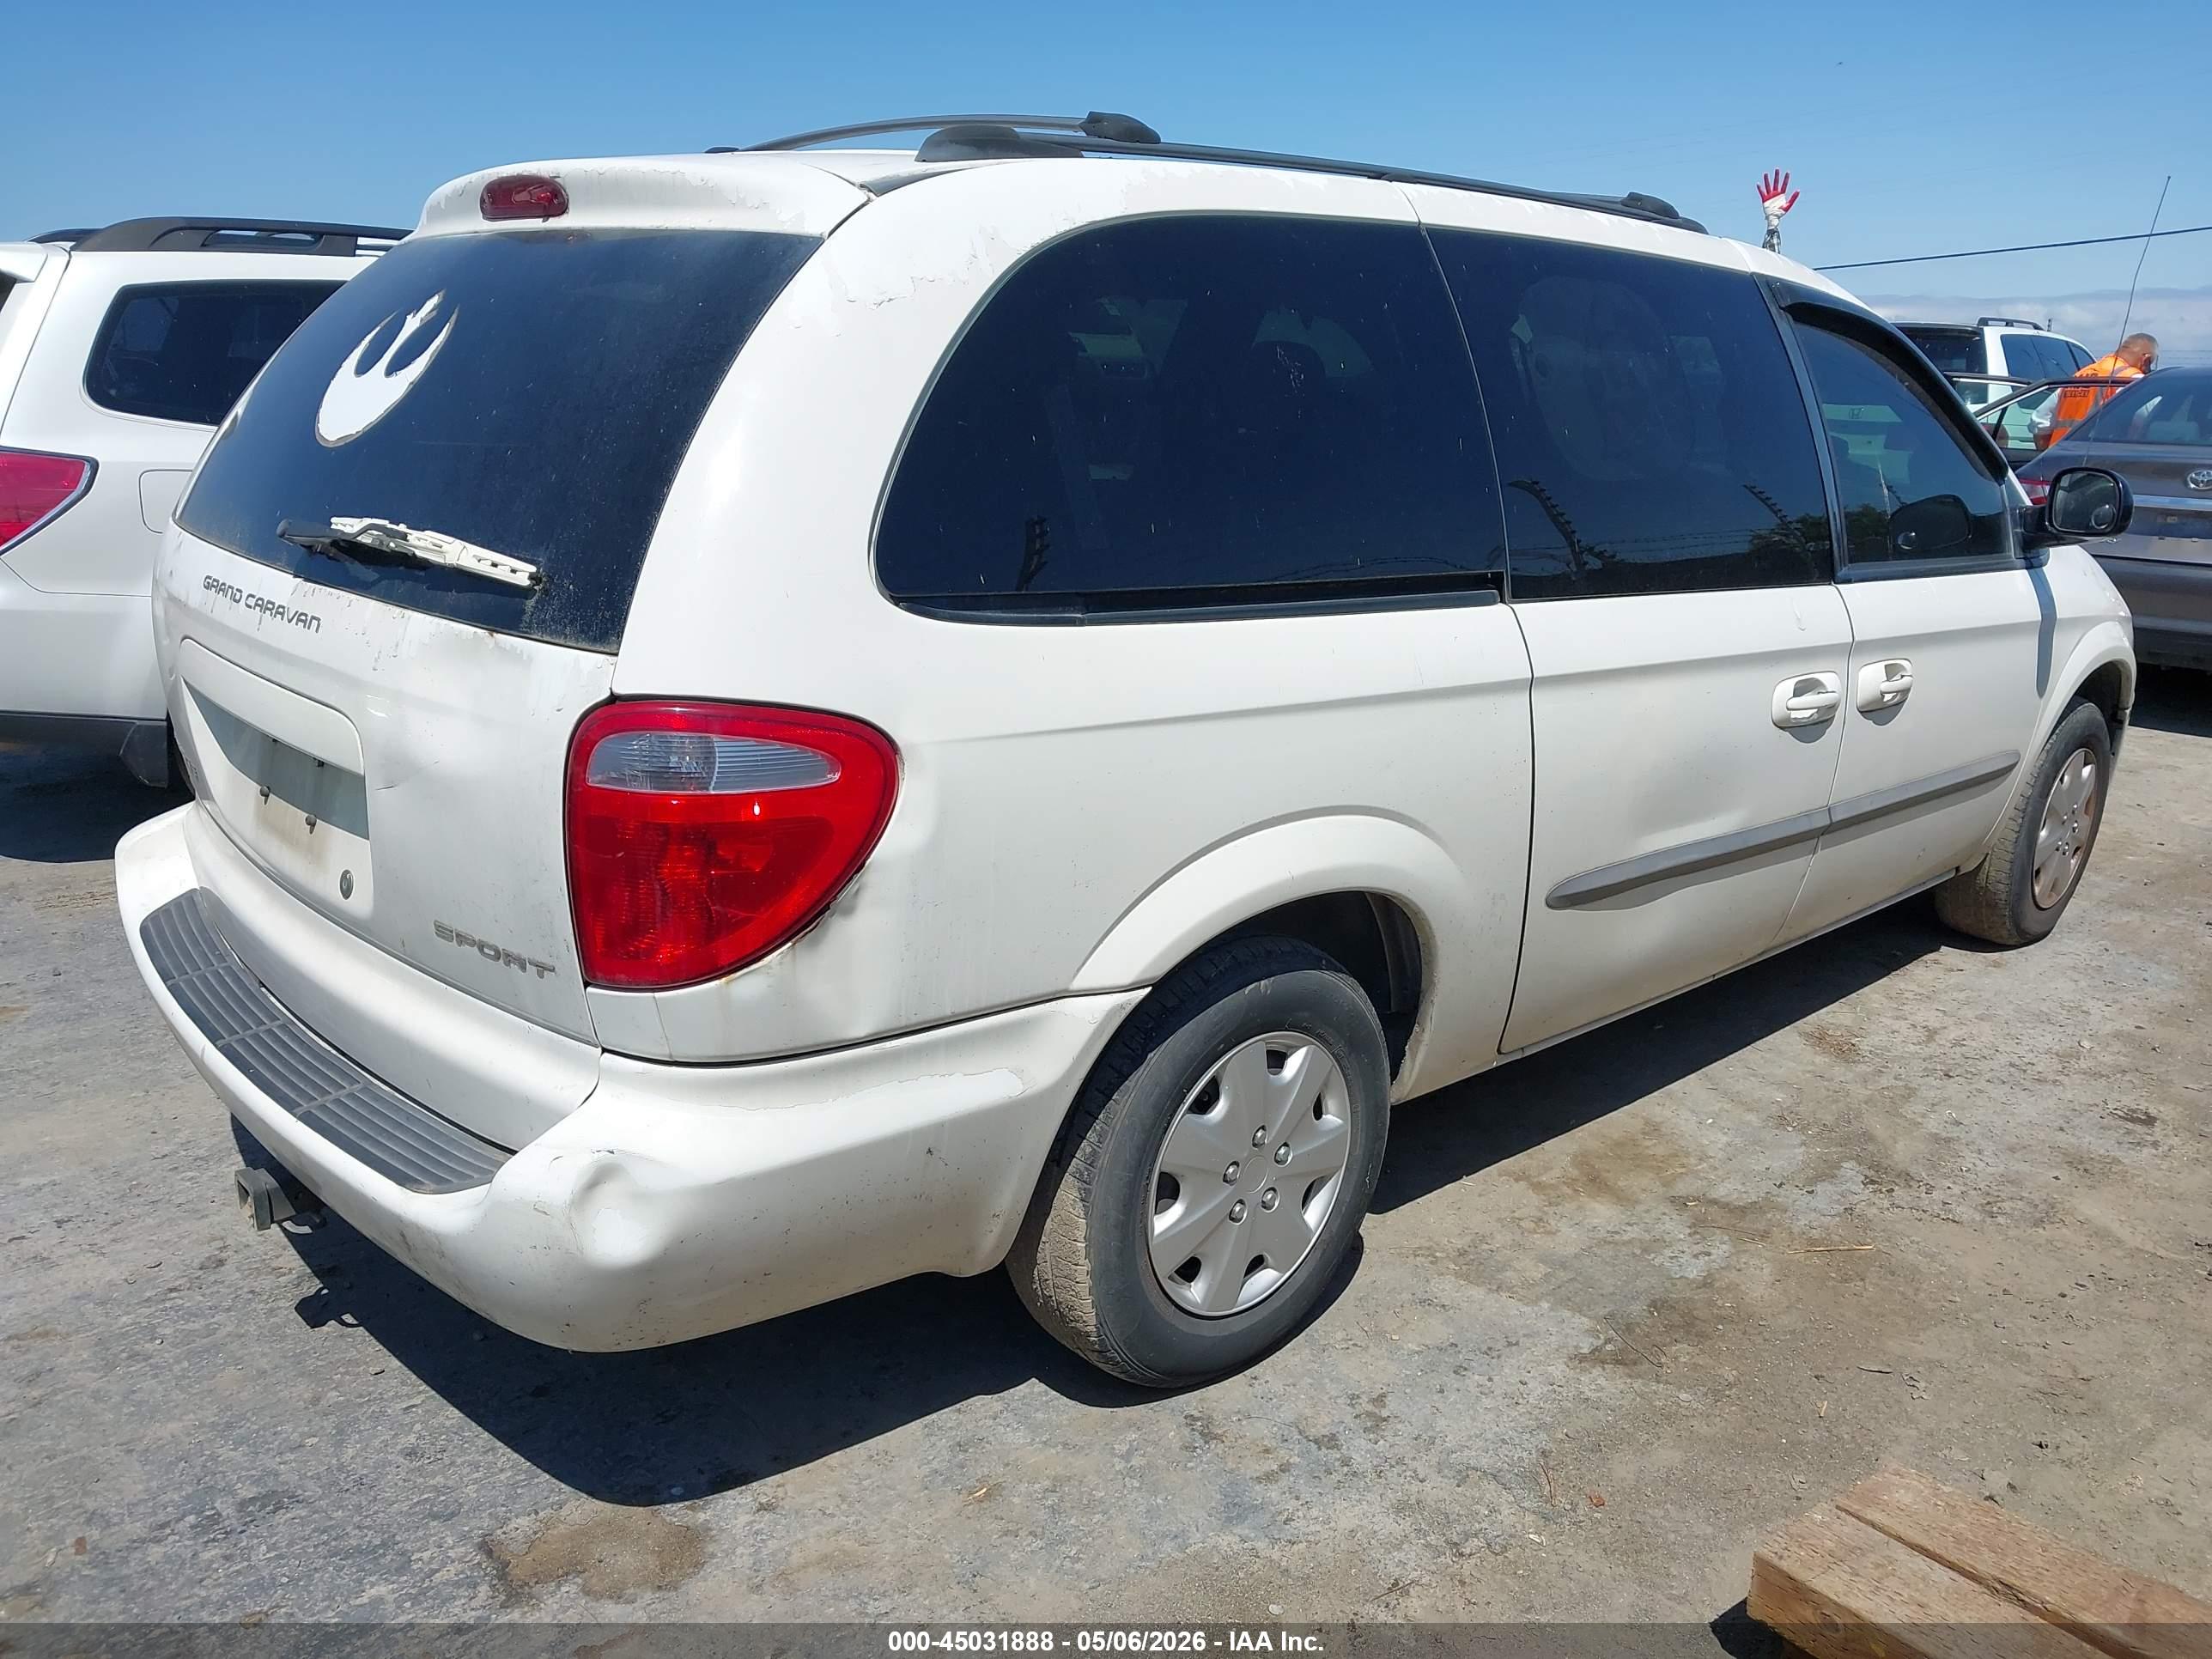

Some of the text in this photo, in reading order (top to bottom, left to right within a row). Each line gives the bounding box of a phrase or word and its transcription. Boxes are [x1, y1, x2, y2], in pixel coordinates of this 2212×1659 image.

[203, 574, 322, 634] GRAND CARAVAN
[433, 920, 556, 980] SPORT
